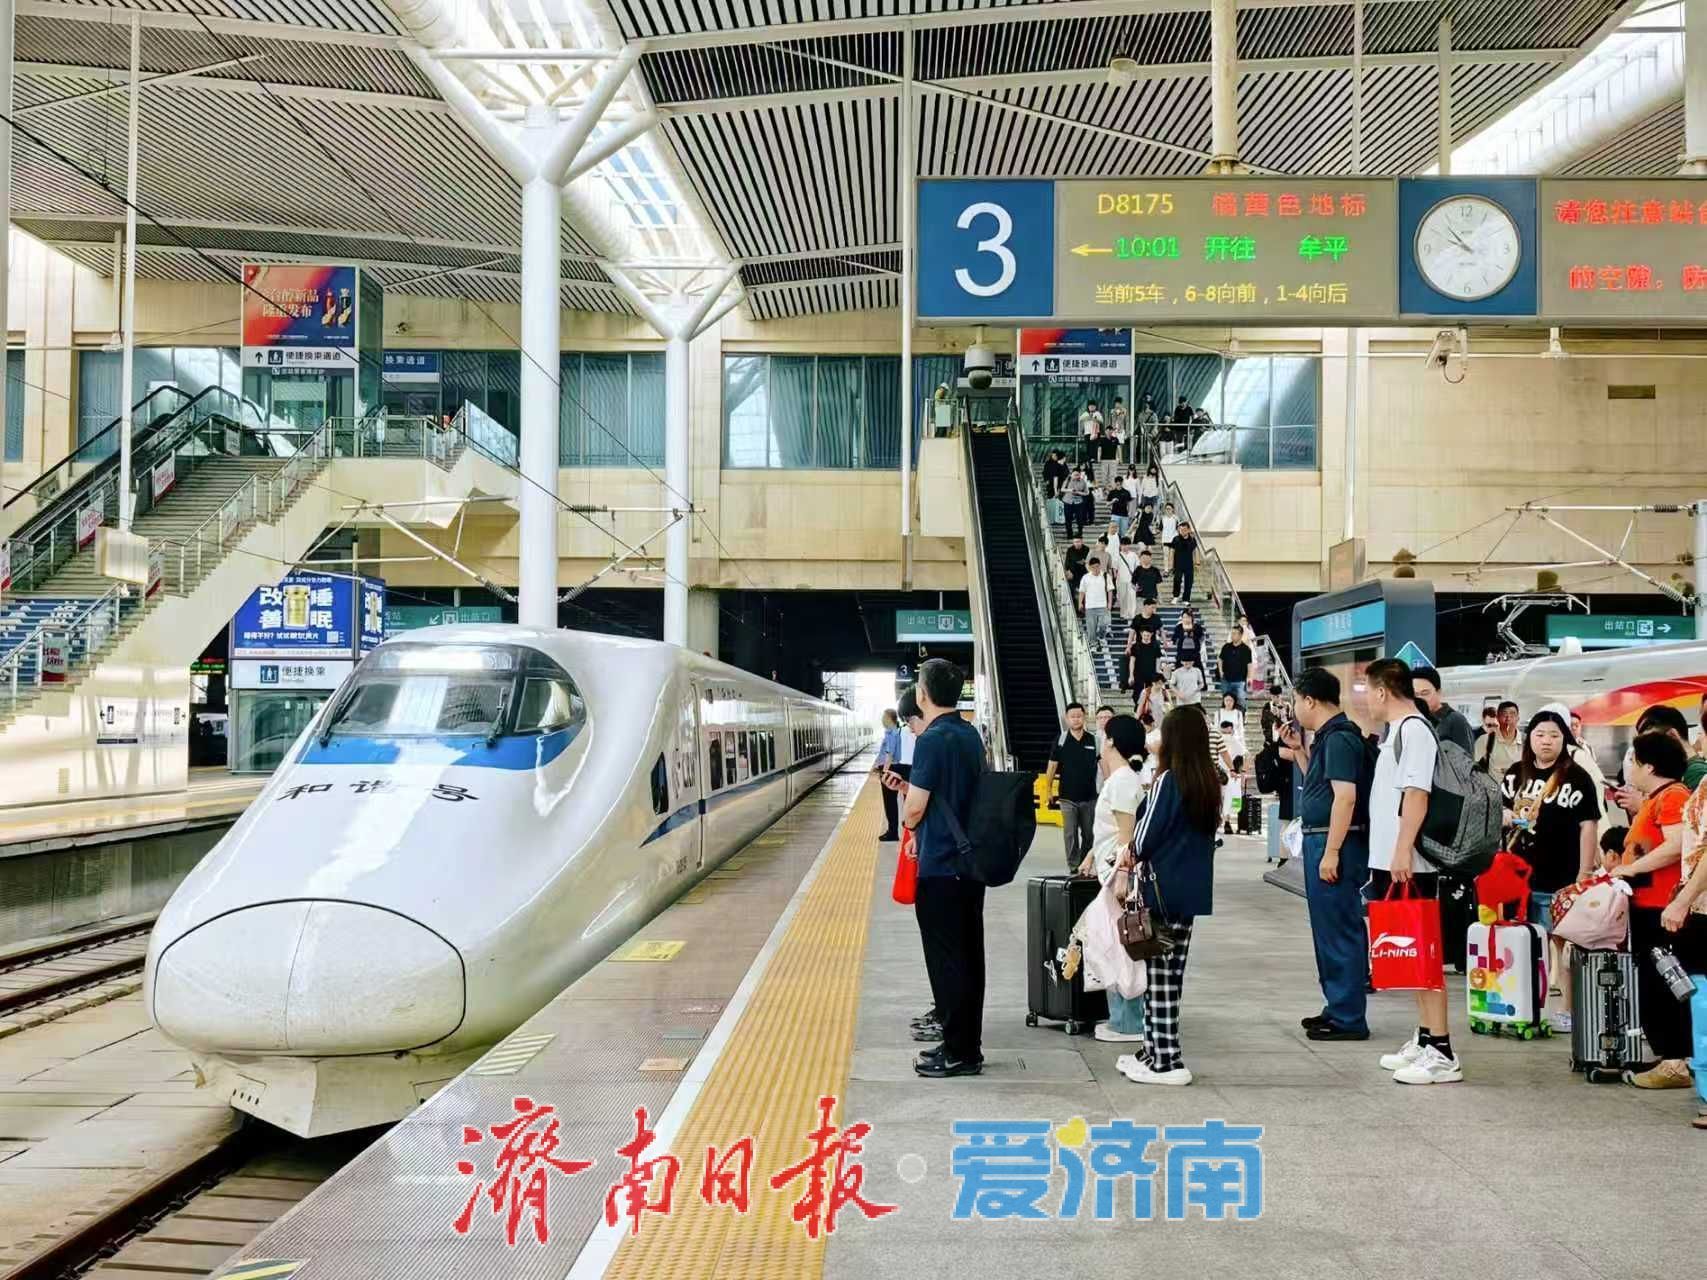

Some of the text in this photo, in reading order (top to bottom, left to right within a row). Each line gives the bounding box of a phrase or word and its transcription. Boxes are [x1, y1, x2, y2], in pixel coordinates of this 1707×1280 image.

[1097, 193, 1174, 215] D8175
[1460, 205, 1473, 217] 12
[954, 202, 1017, 297] 3
[1115, 236, 1349, 262] 10:01 开往 牟平
[1371, 947, 1418, 958] LI-NING
